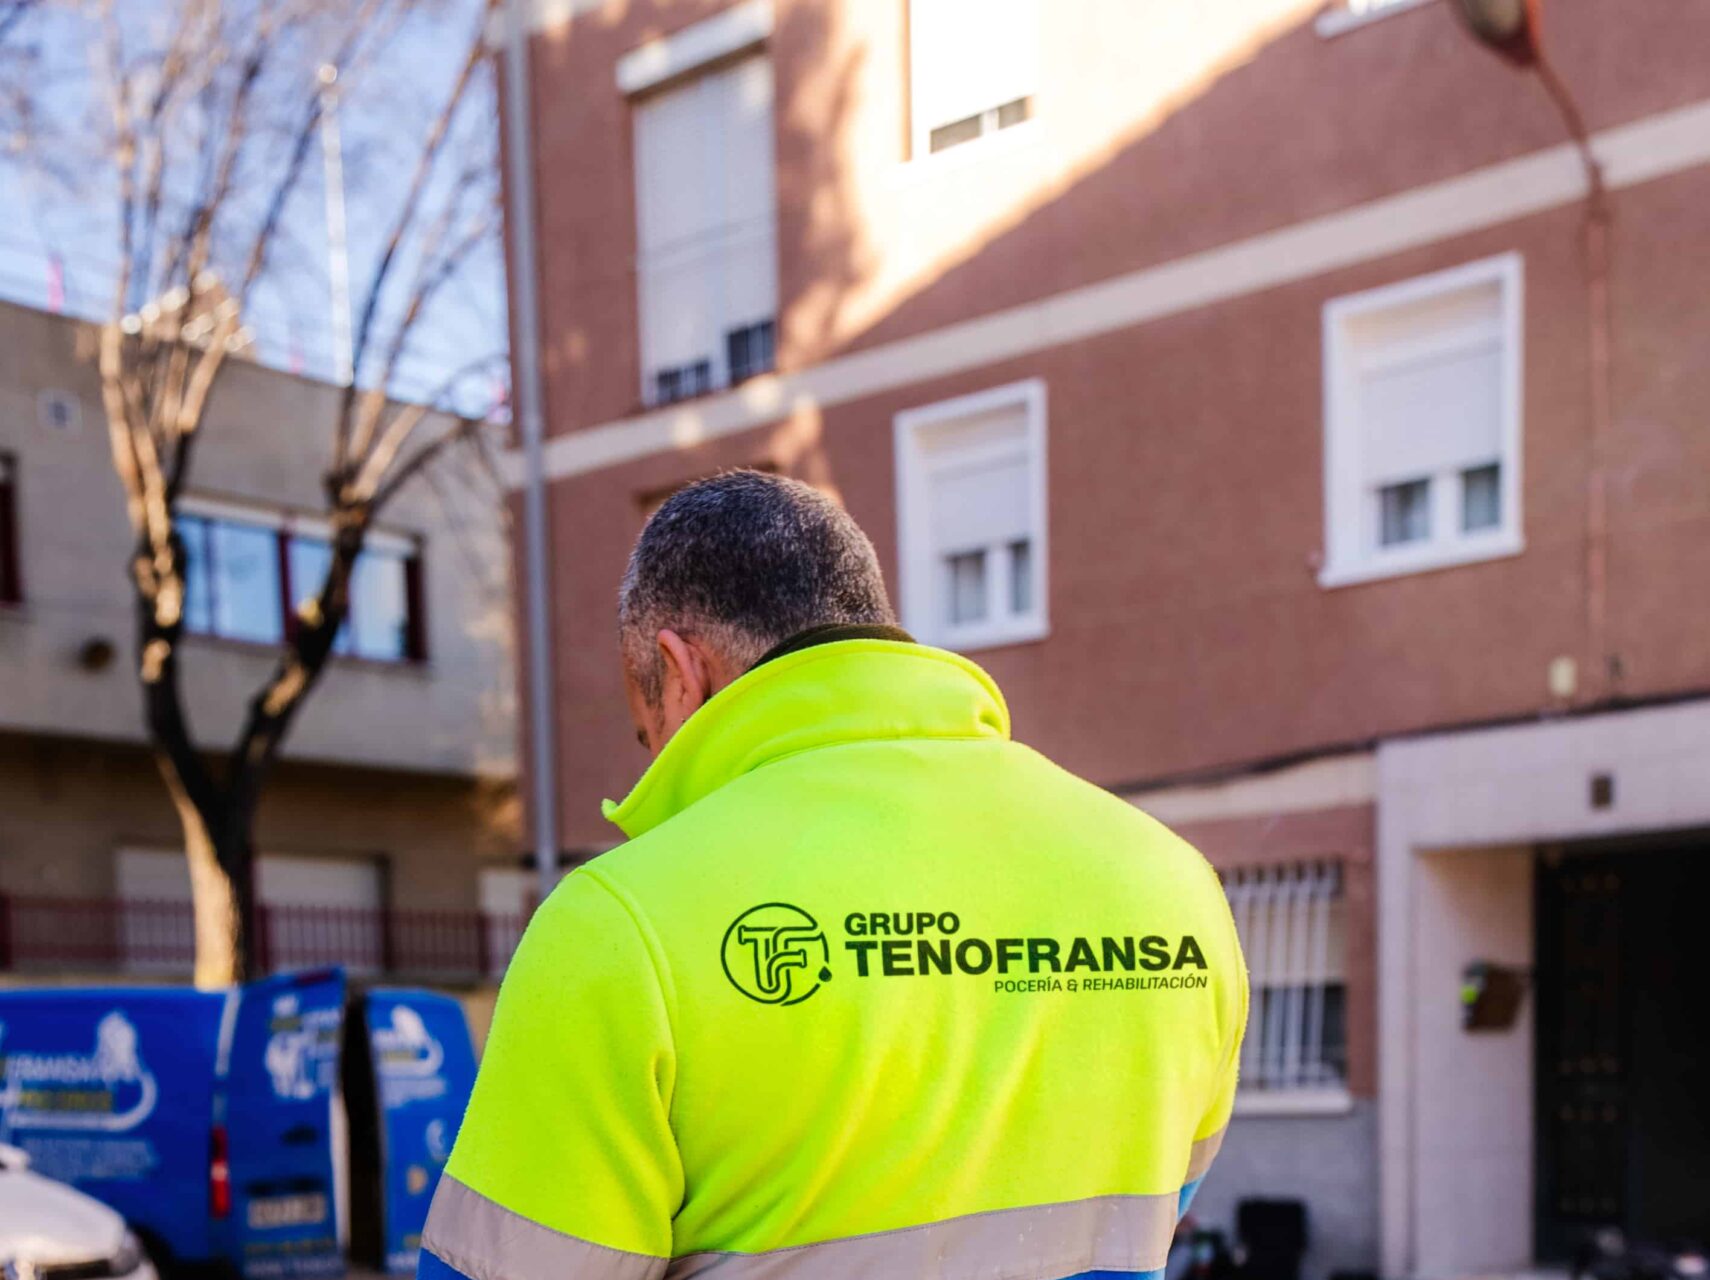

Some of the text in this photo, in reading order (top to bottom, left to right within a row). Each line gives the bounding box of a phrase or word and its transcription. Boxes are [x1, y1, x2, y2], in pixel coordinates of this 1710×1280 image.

[844, 911, 960, 936] GRUPO
[844, 936, 1208, 977] TENOFRANSA
[994, 974, 1208, 993] POCERÍA & REHABILITACIÓN
